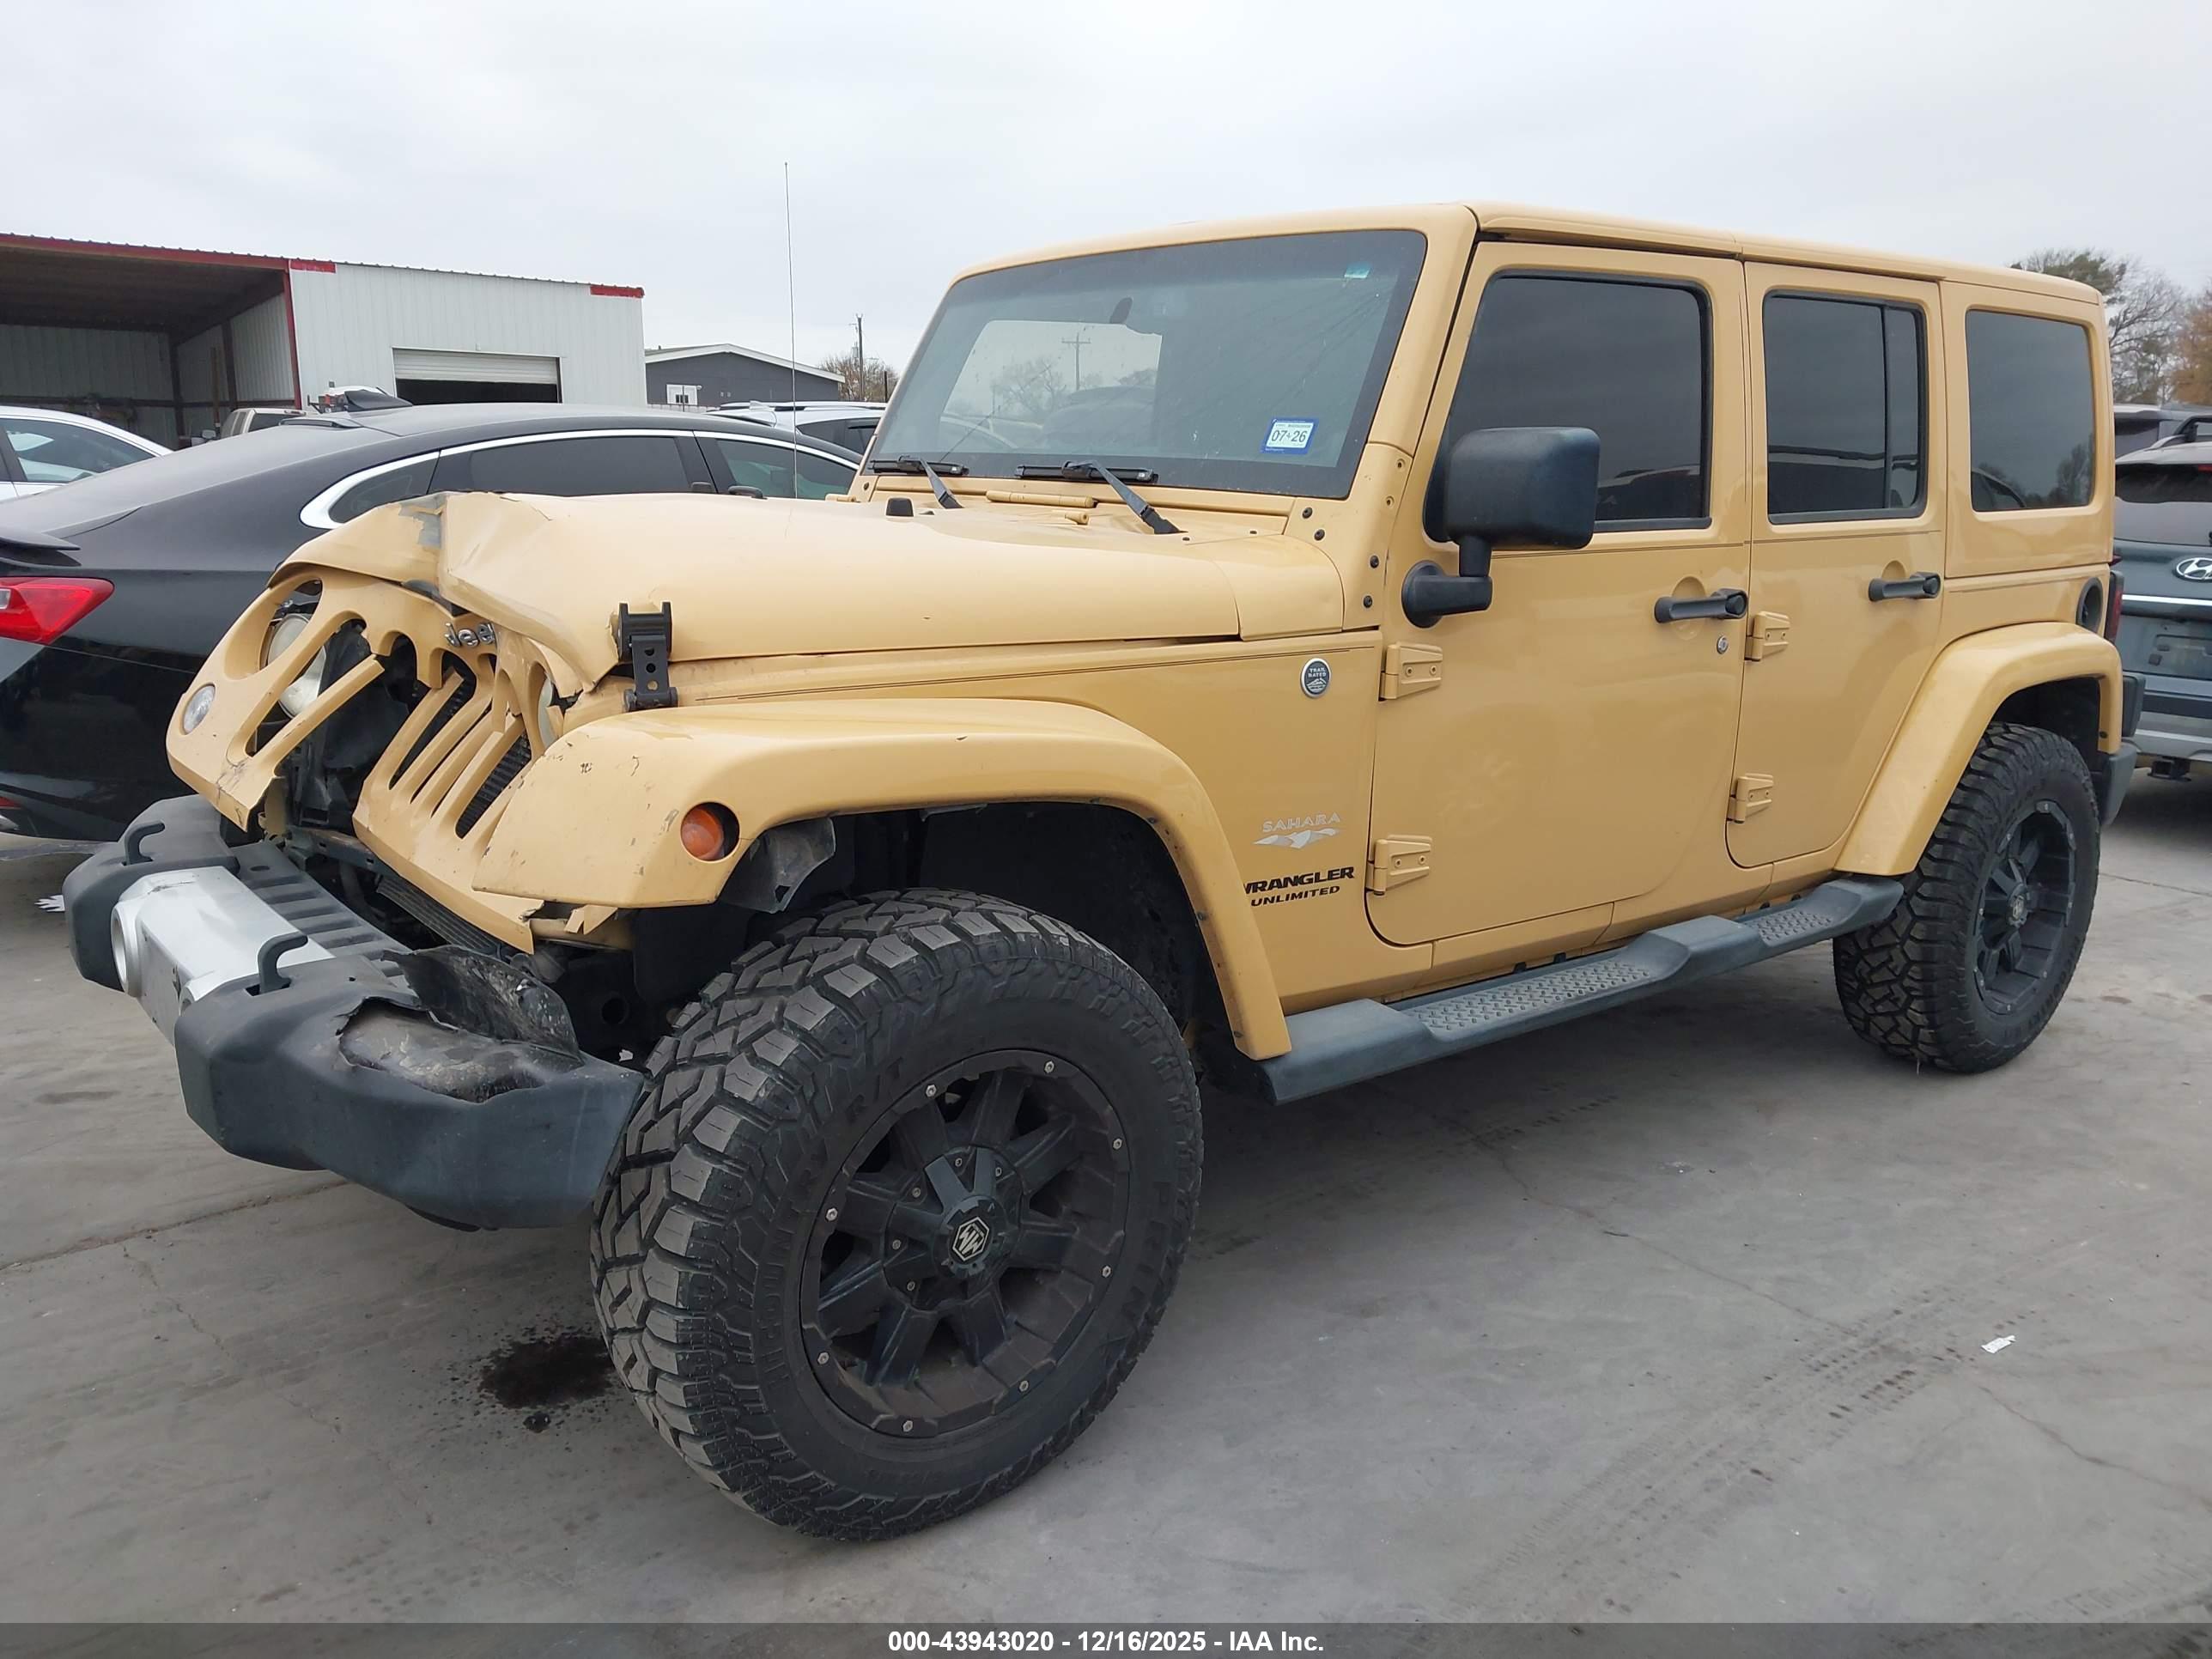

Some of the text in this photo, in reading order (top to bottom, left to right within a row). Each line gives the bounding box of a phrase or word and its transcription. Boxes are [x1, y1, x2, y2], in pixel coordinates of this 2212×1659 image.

[445, 622, 495, 647] Jee
[1261, 812, 1341, 833] SAHARA
[1251, 885, 1340, 907] UNLIMITED
